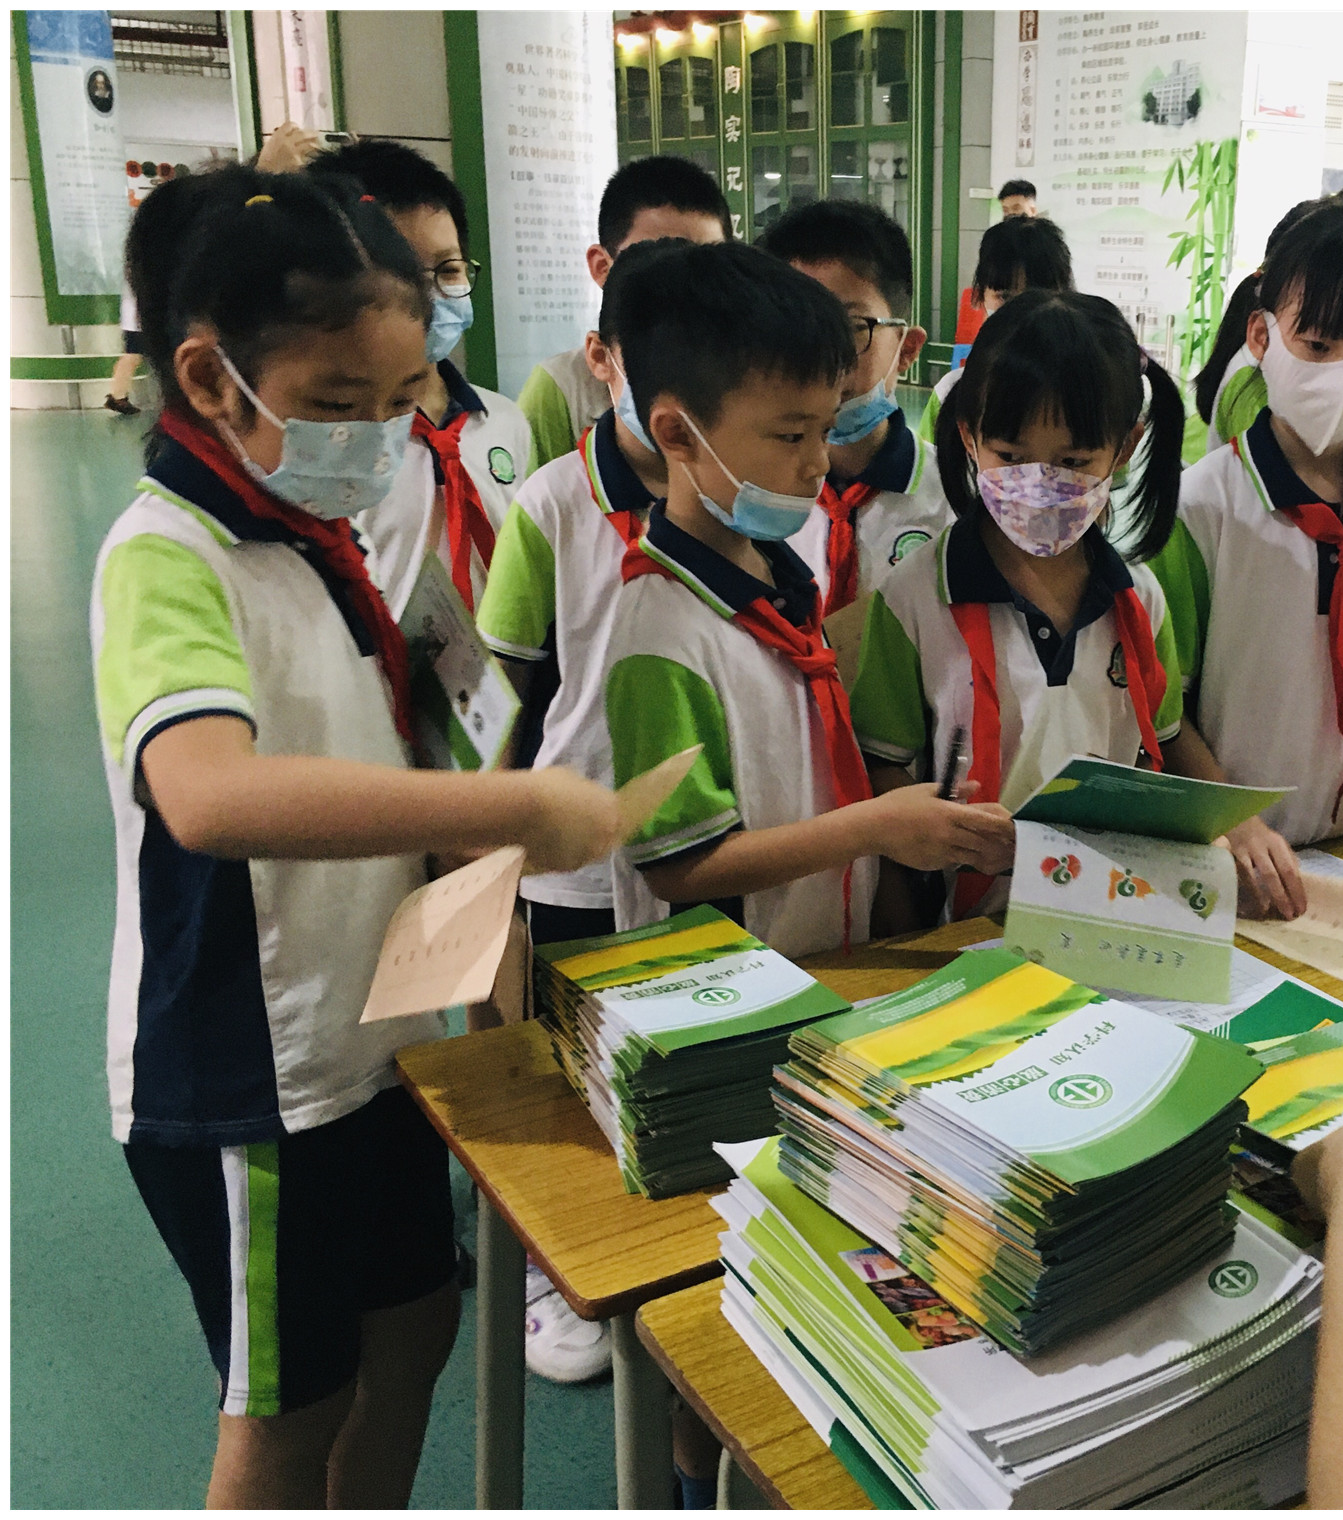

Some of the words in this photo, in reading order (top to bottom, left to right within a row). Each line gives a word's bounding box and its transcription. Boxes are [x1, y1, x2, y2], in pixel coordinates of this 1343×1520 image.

[1049, 1020, 1116, 1066] 科学认知
[957, 1064, 1049, 1103] 放心消费
